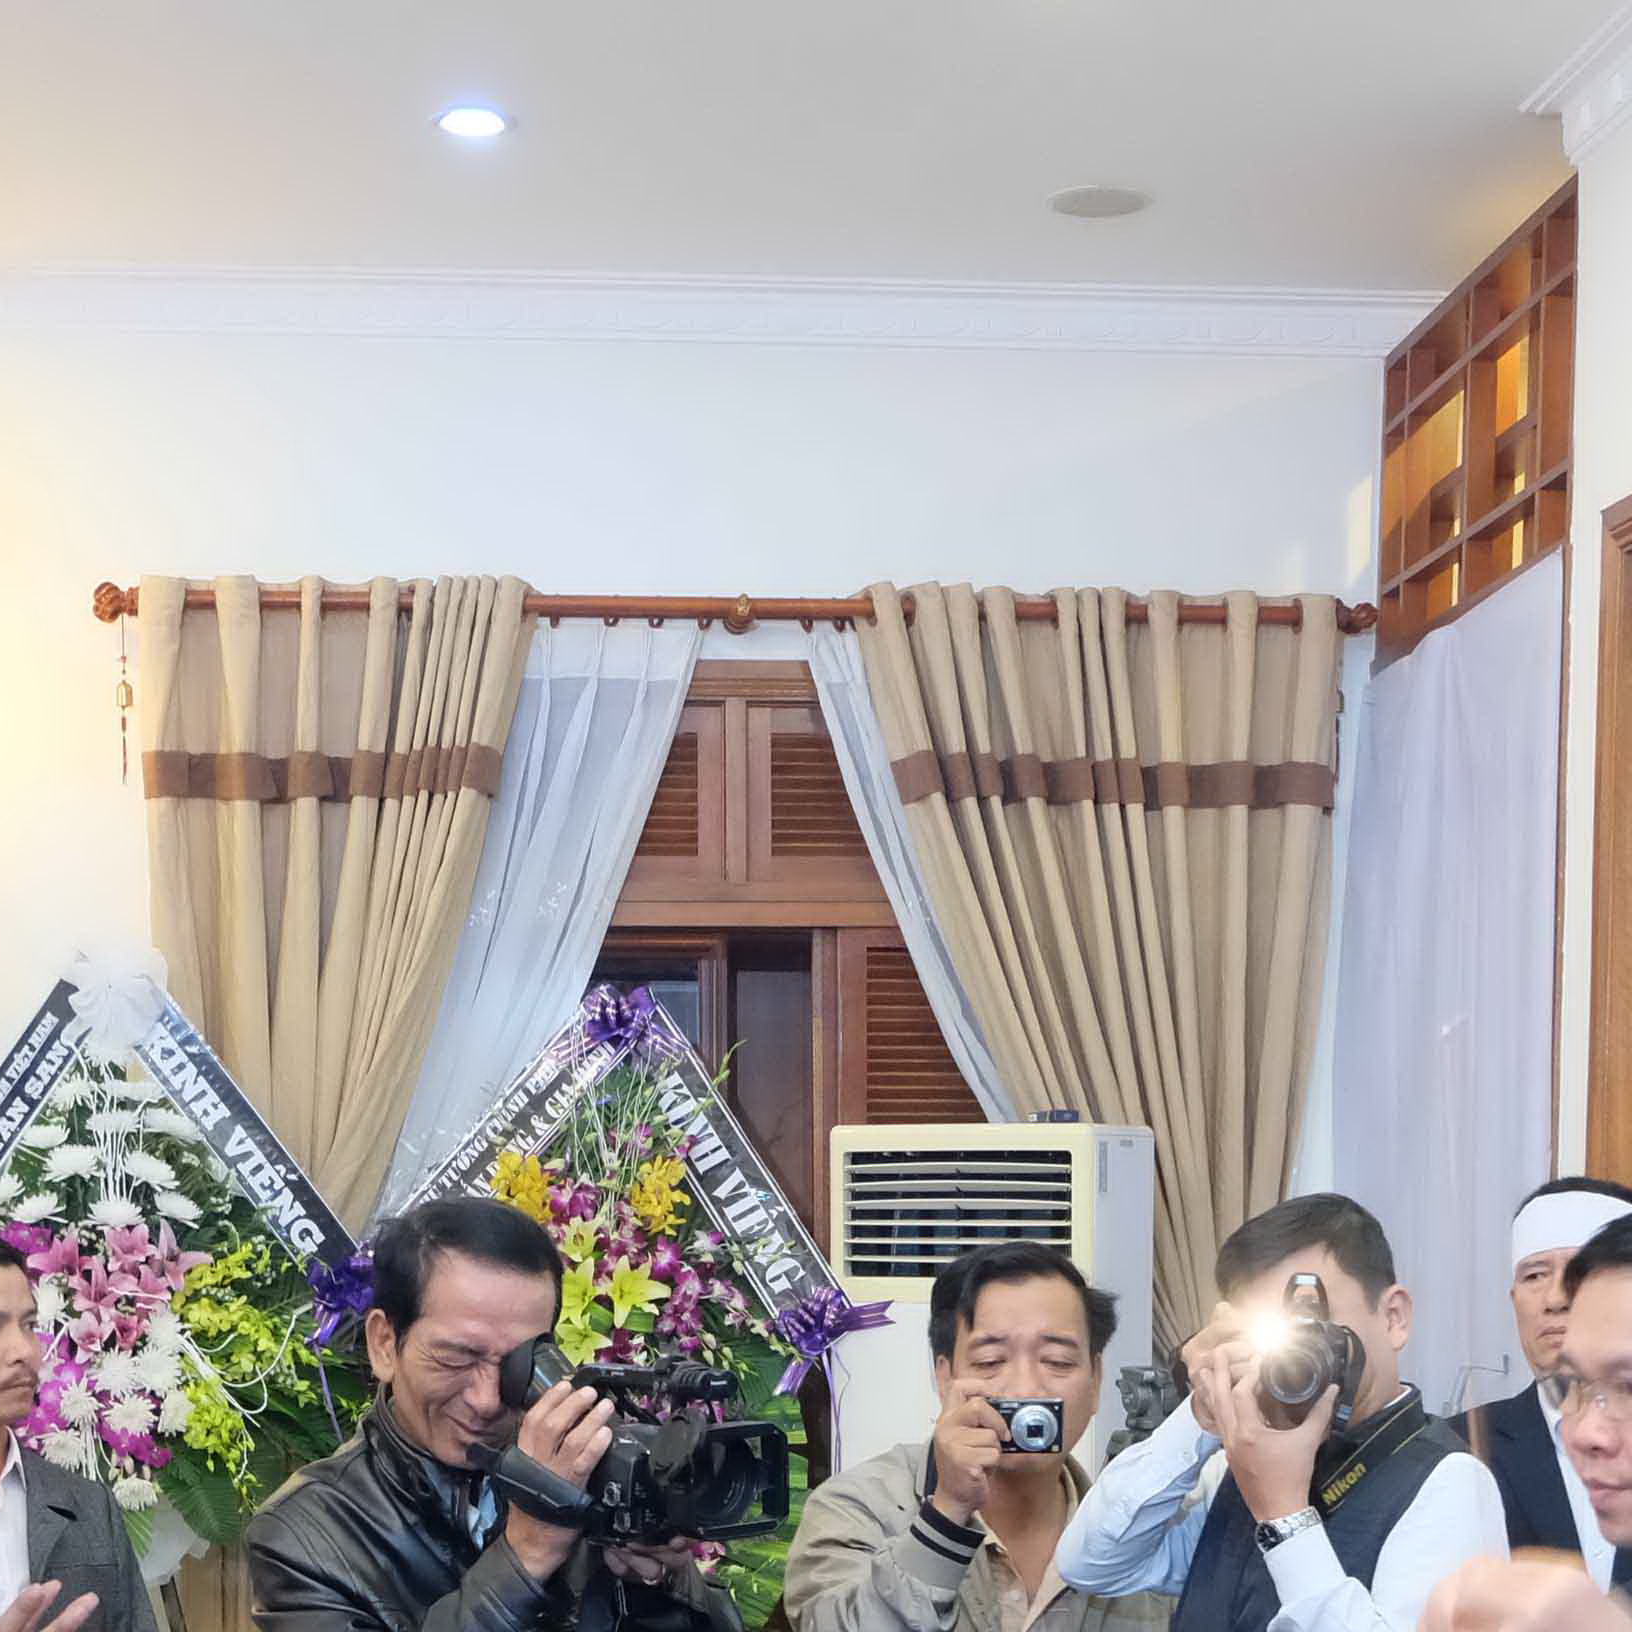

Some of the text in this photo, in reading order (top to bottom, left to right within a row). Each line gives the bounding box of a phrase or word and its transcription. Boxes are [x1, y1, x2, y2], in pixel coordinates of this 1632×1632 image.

[28, 1011, 60, 1054] NAM
[24, 1040, 69, 1099] SAN
[148, 1022, 325, 1256] KÍNH VIẾNG
[439, 1135, 489, 1190] TƯỚNG
[712, 1167, 806, 1294] VIẾNG
[1322, 1463, 1367, 1505] Nikon
